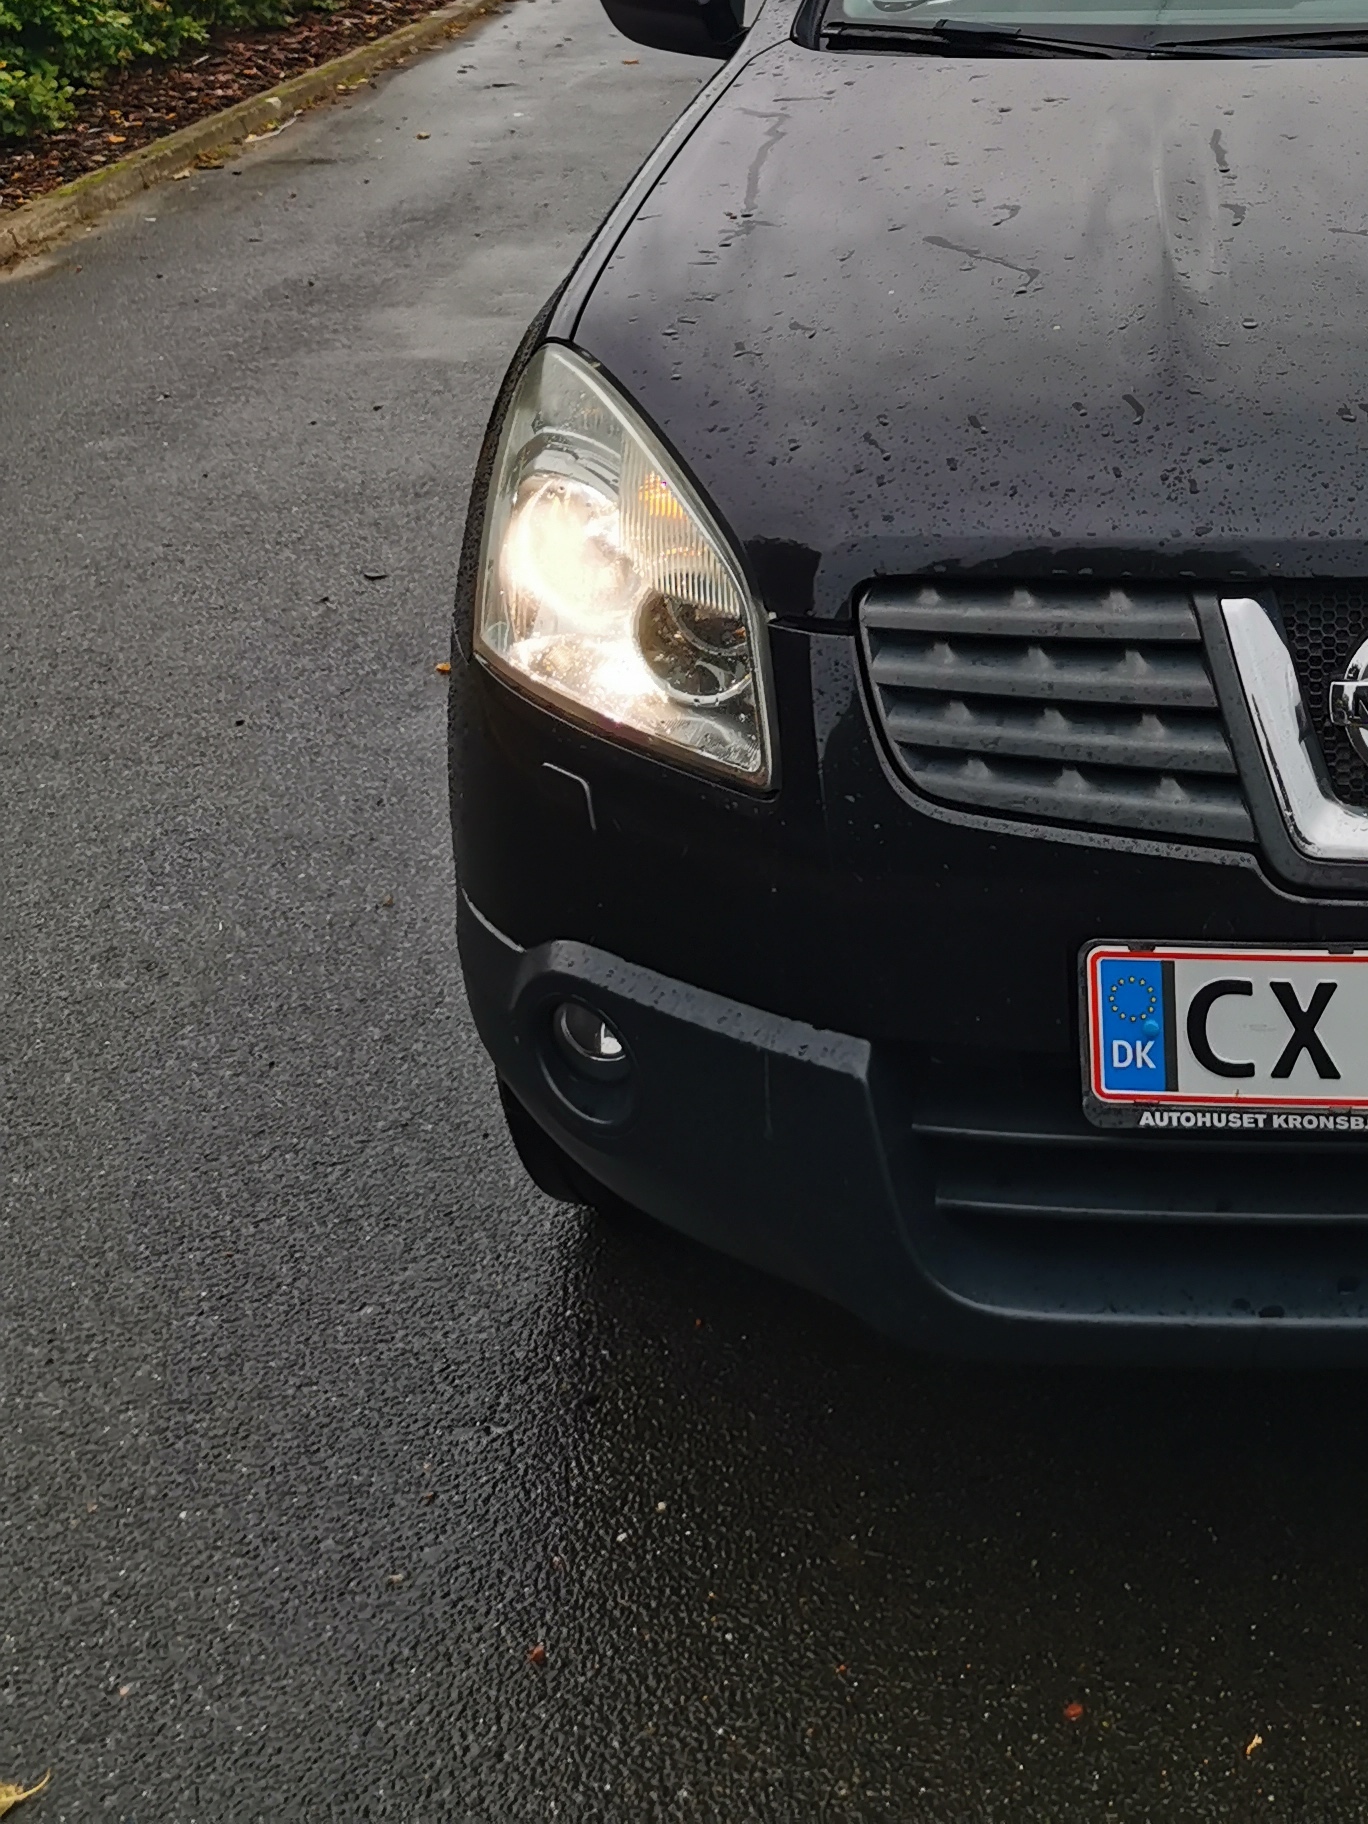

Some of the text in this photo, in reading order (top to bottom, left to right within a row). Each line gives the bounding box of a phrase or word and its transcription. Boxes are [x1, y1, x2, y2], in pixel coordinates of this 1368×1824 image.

[1185, 978, 1343, 1081] CX
[1111, 1039, 1157, 1069] DK
[1138, 1110, 1267, 1129] AUTOHUSET
